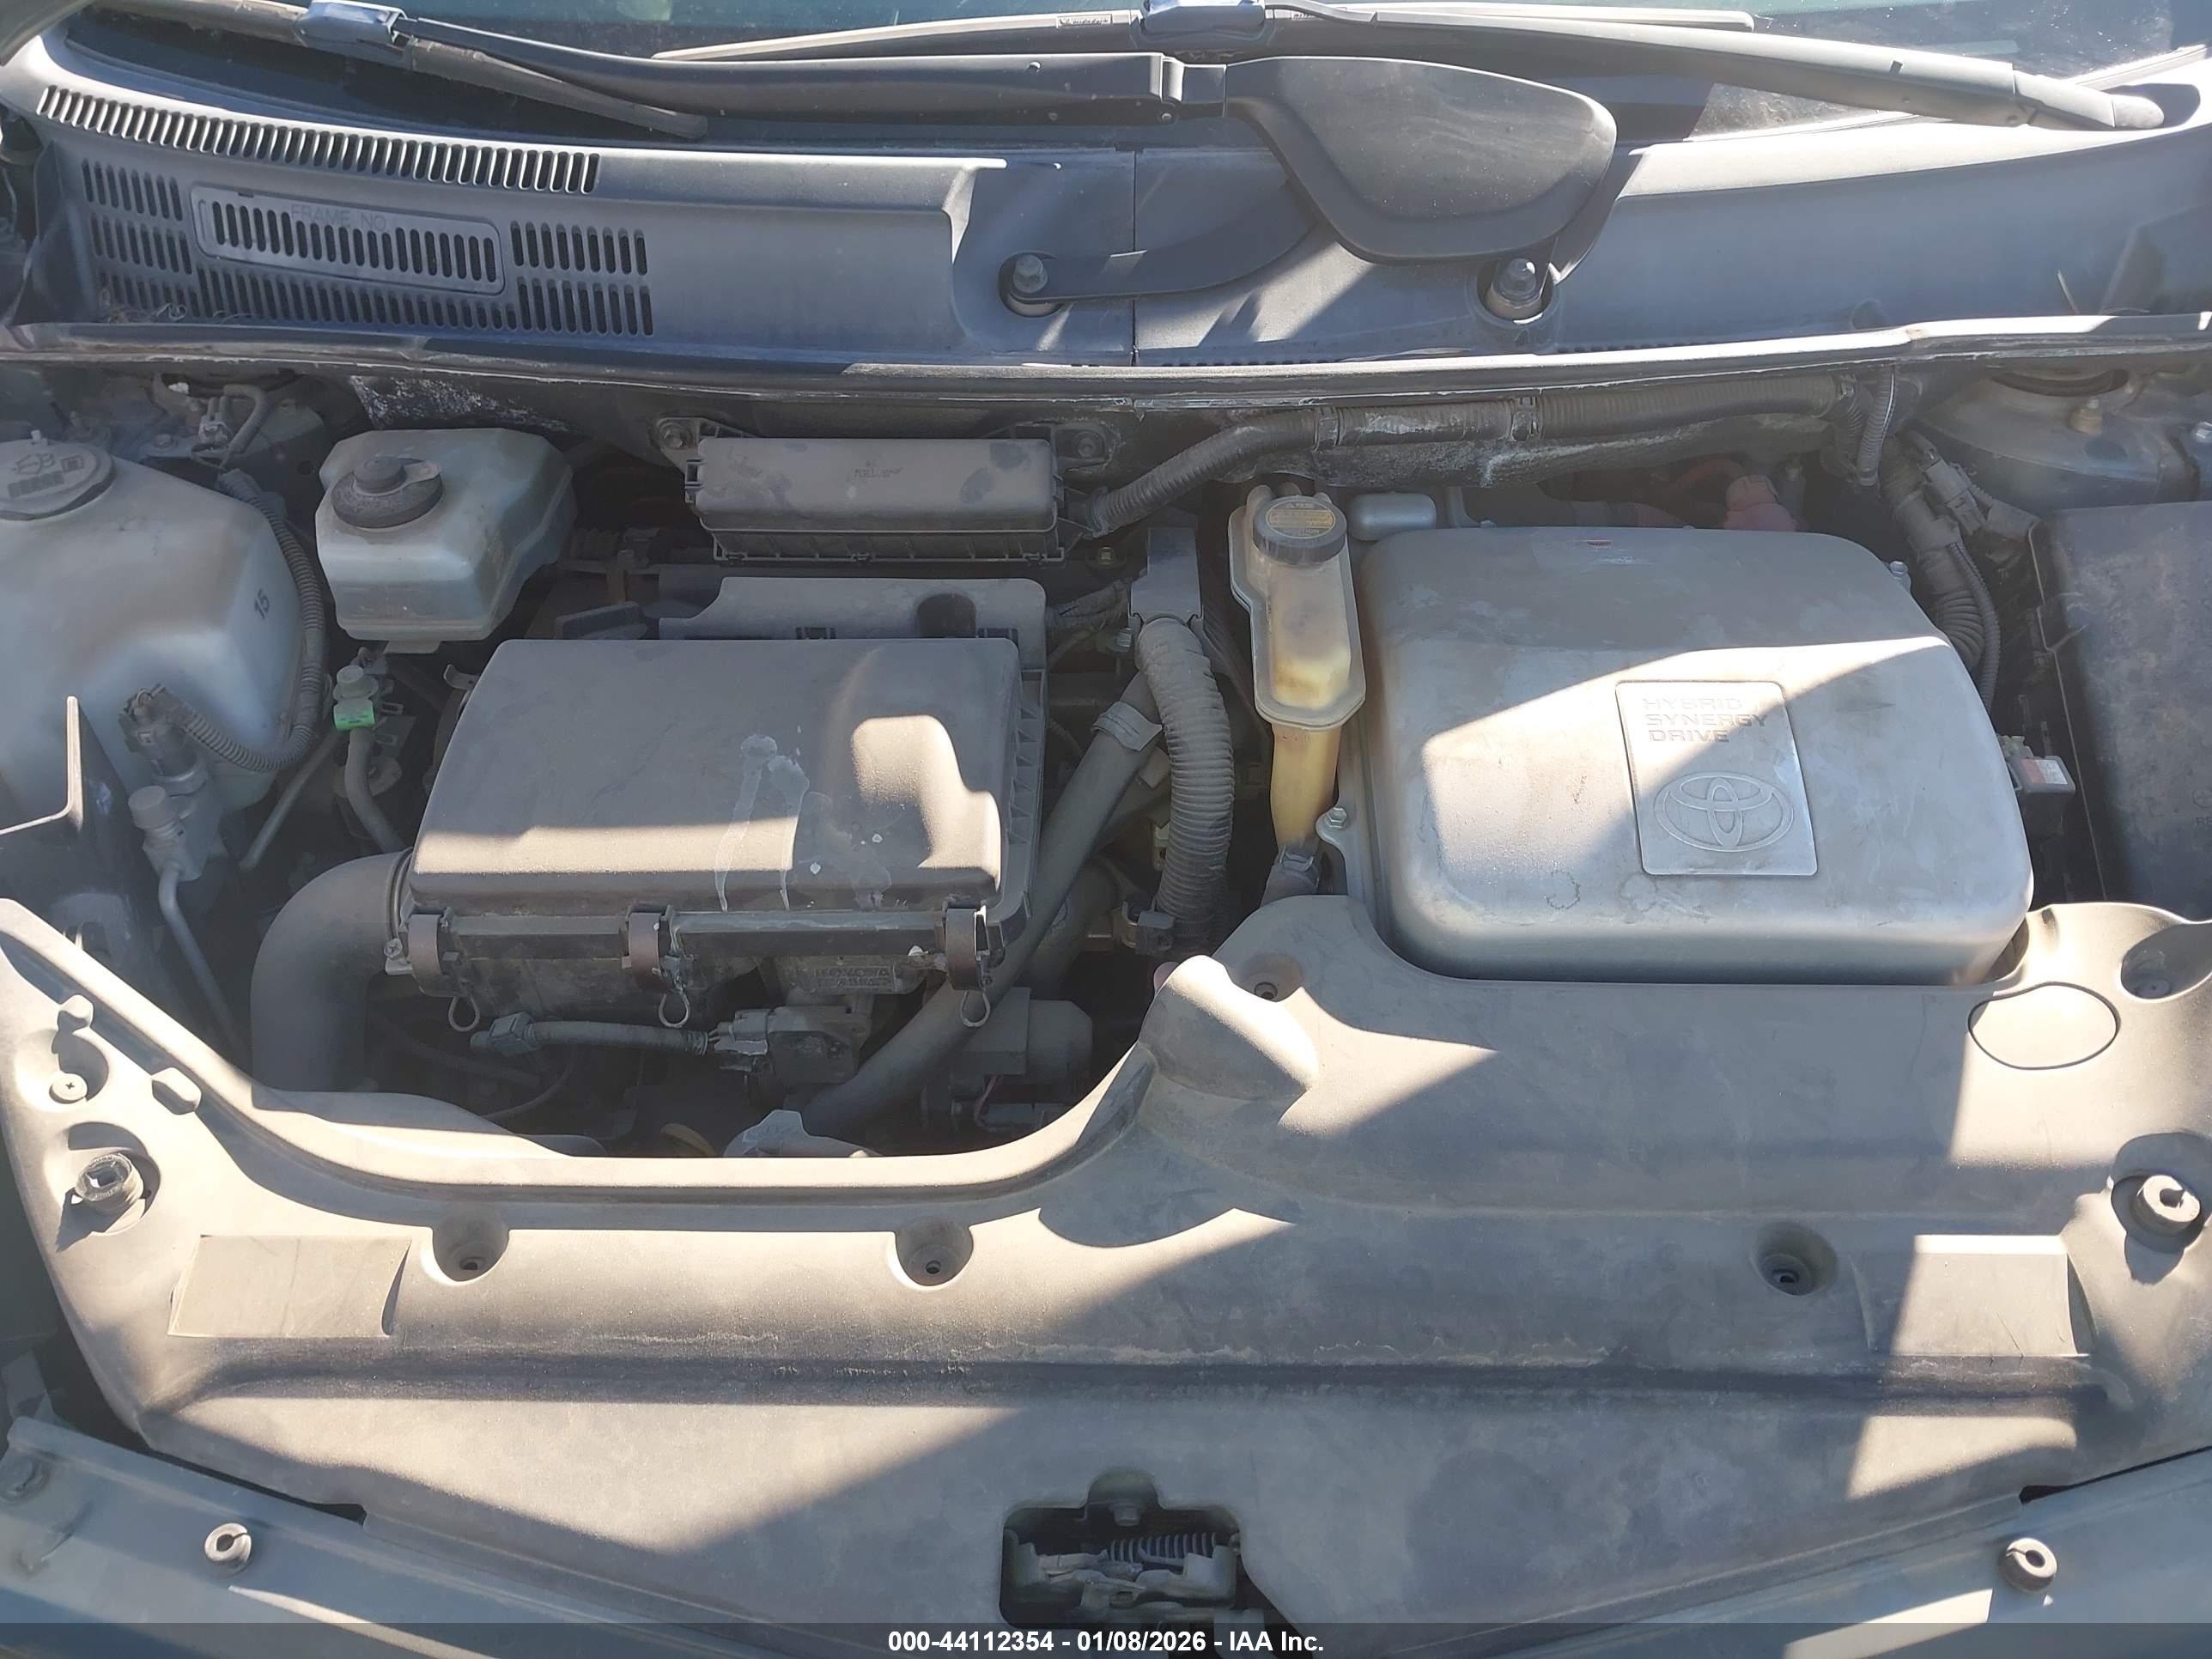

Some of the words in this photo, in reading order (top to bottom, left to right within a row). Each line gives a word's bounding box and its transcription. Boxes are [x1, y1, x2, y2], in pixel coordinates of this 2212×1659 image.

[291, 204, 351, 228] FRAME
[1643, 696, 1743, 710] HYBRID
[1645, 714, 1769, 727] SYNERGY
[1648, 730, 1730, 743] DRIVE
